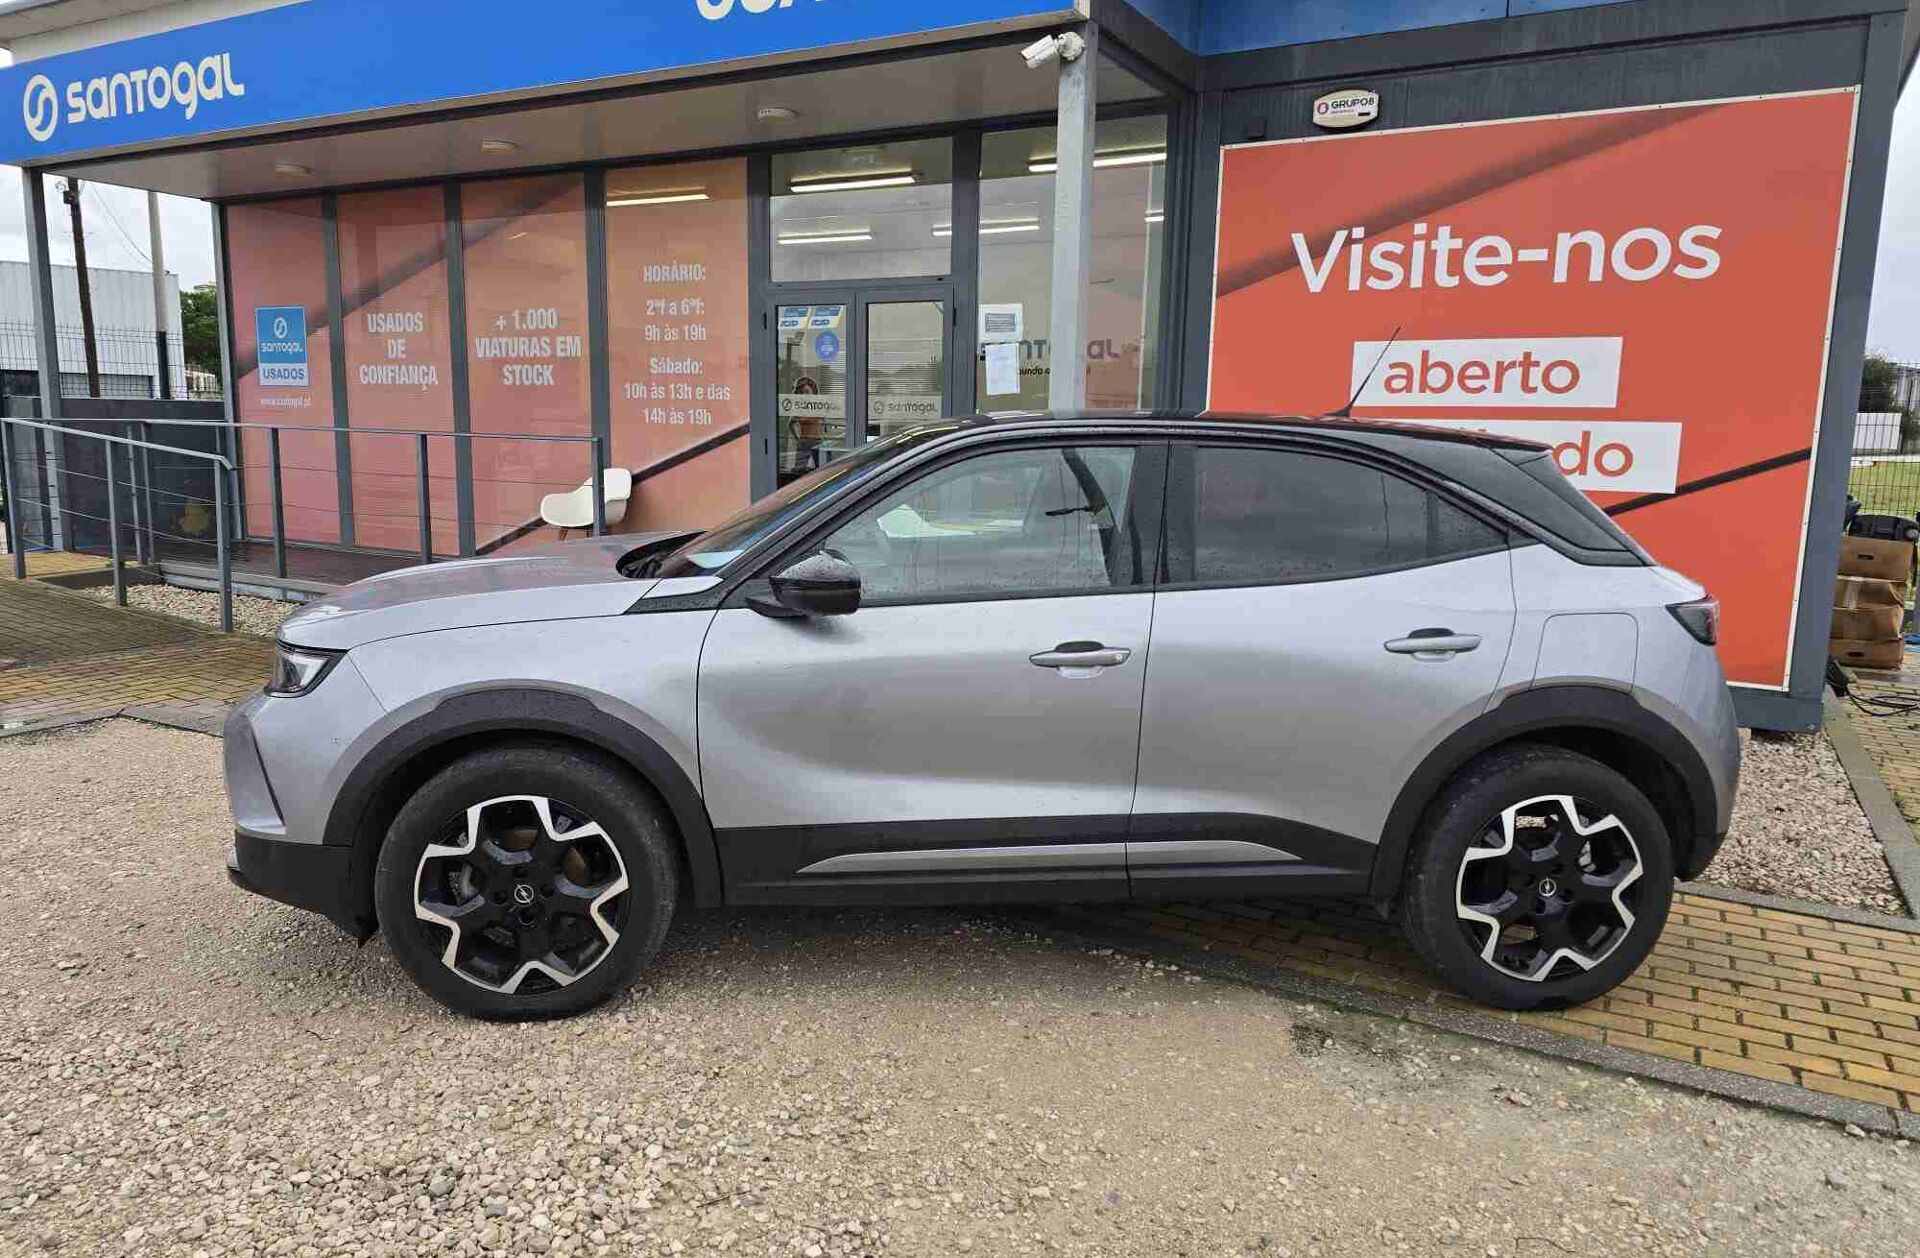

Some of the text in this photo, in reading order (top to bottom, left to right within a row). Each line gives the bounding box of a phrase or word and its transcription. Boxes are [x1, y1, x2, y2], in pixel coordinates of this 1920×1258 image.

[1291, 223, 1723, 293] Visite-nos
[643, 259, 706, 283] HORÁRIO:
[367, 312, 423, 333] USADOS
[512, 308, 557, 330] 1.000
[645, 325, 660, 341] 9h
[683, 324, 706, 341] 19h
[388, 339, 407, 359] DE
[475, 335, 583, 358] VIATURAS EM
[263, 368, 305, 381] USADOS
[503, 364, 555, 386] STOCK
[649, 357, 703, 374] Sábado:
[1383, 350, 1581, 395] aberto
[360, 364, 439, 391] CONFIANÇA
[624, 382, 647, 399] 10h
[669, 383, 692, 400] 13h
[696, 385, 704, 400] e
[708, 383, 731, 400] das
[643, 407, 666, 424] 14h
[689, 408, 712, 425] 19h
